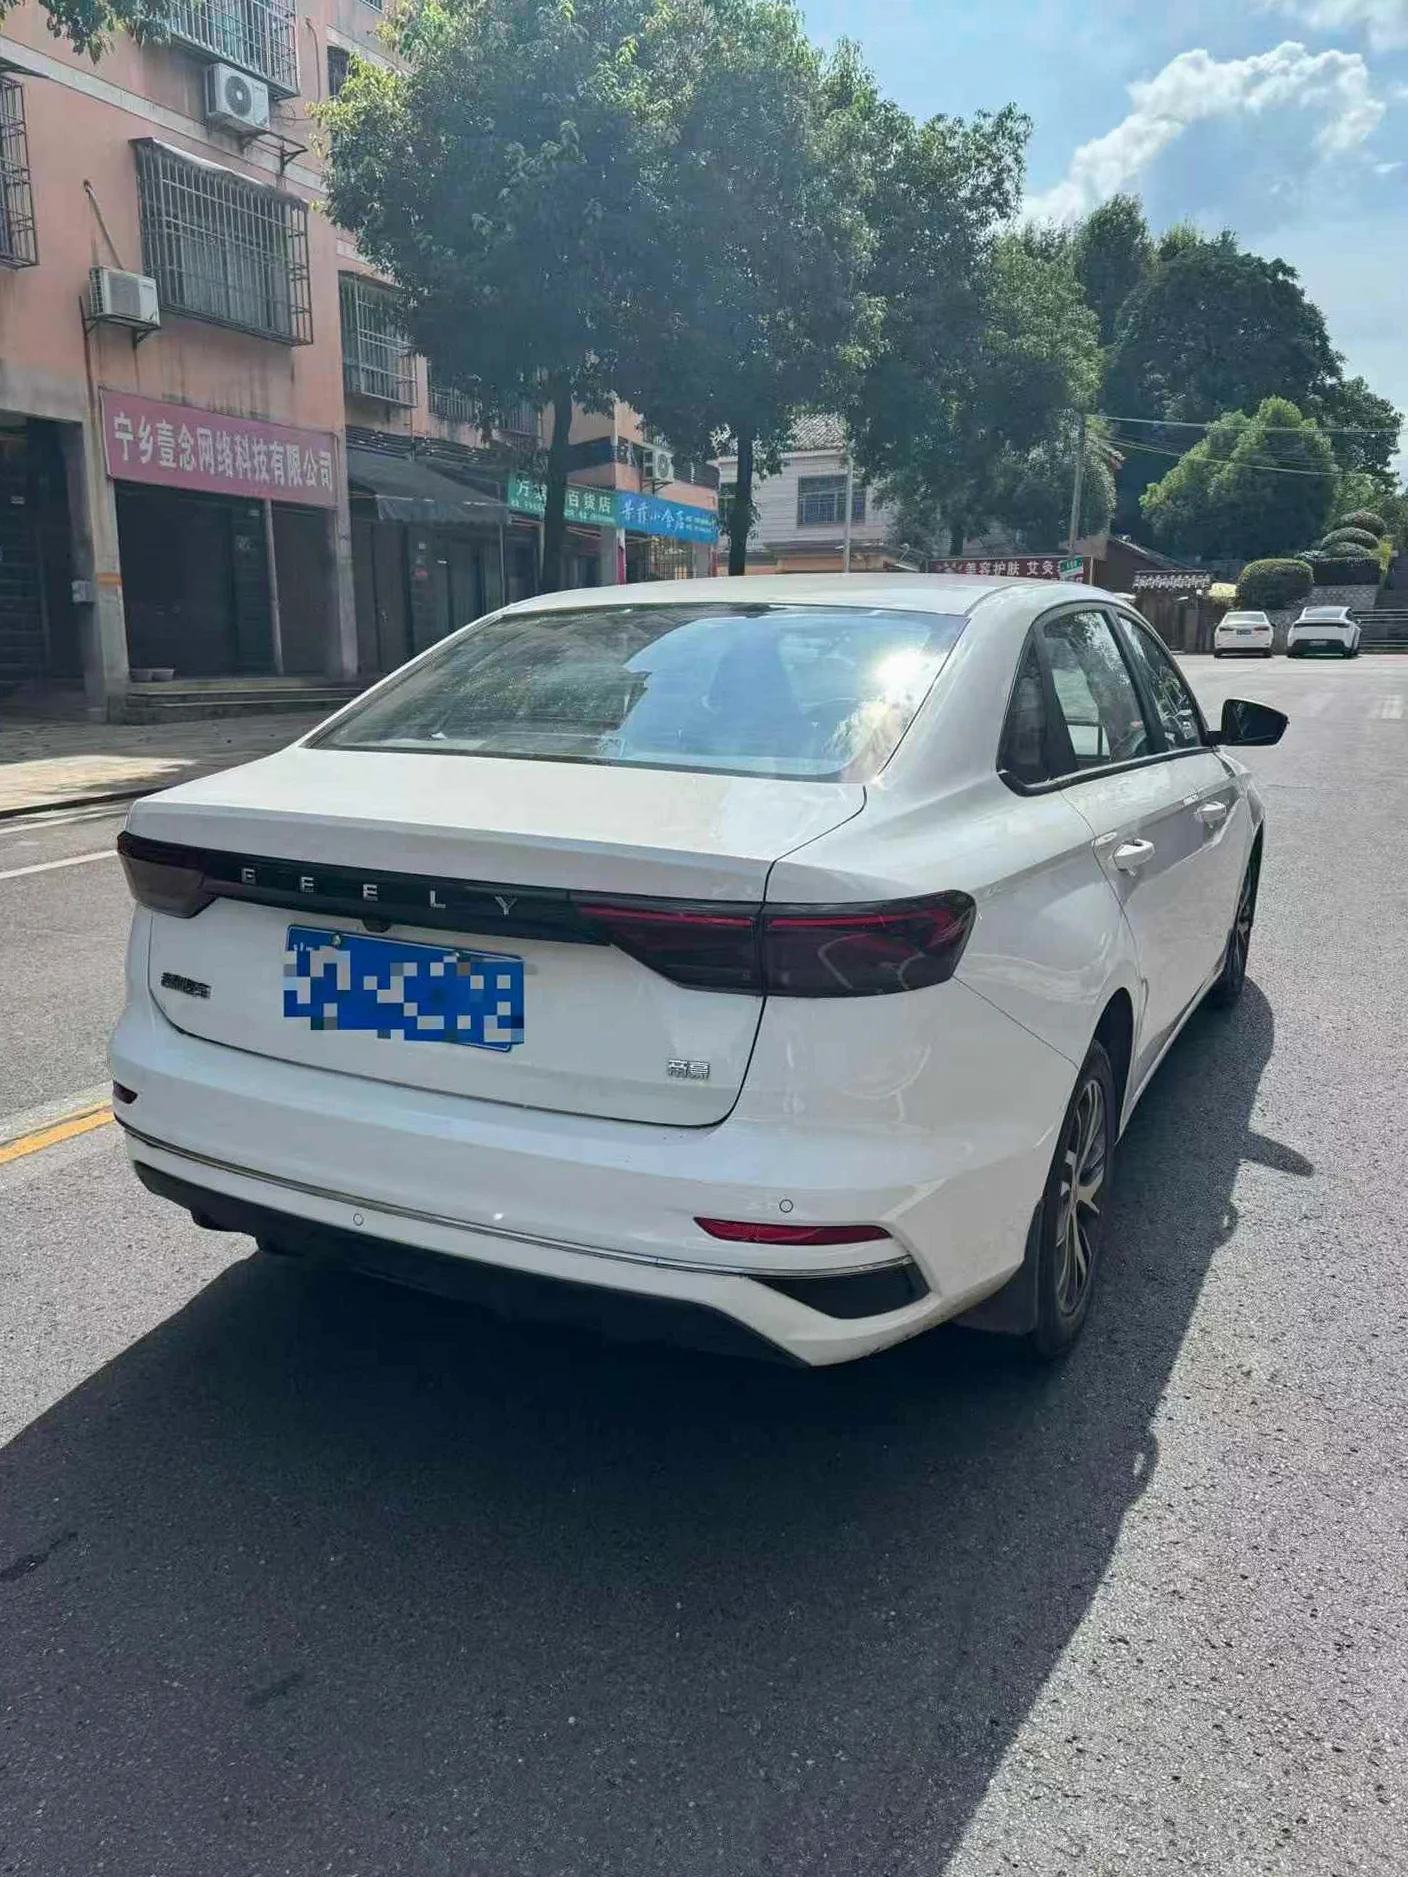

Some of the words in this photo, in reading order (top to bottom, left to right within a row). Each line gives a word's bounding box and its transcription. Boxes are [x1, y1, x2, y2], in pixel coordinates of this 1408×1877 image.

[113, 411, 333, 492] 宁乡壹念网络科技有限公司
